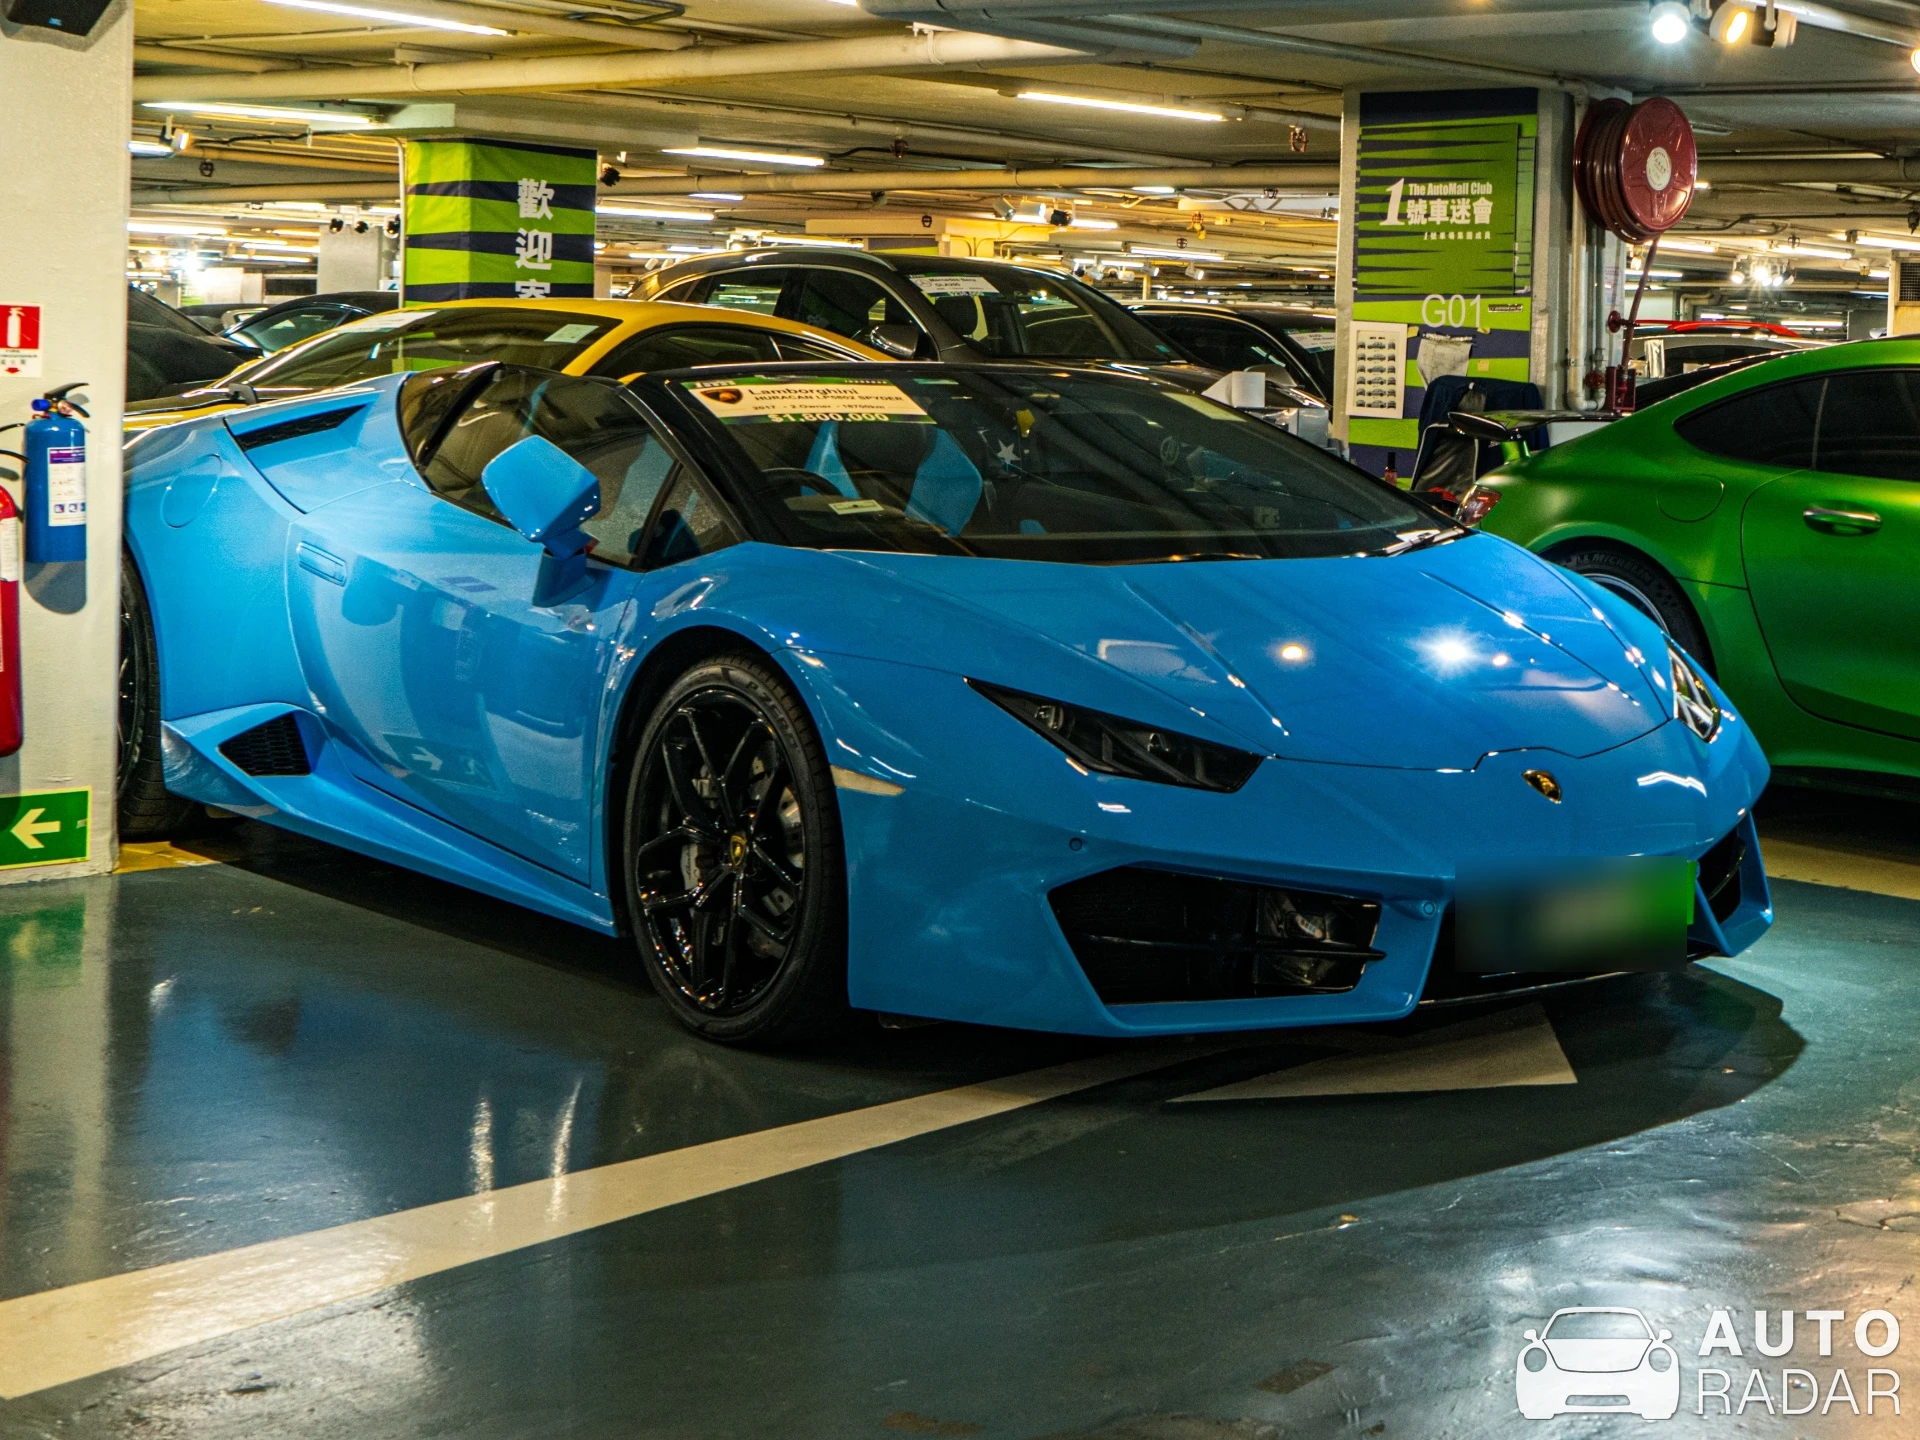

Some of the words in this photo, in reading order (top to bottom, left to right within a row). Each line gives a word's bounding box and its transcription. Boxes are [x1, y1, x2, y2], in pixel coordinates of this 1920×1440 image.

[1408, 183, 1426, 196] The
[1427, 182, 1469, 196] AutoMall
[1470, 181, 1493, 195] Club
[1421, 293, 1481, 328] G01
[747, 388, 859, 396] Lamborghini
[767, 413, 890, 423] $1,800,000
